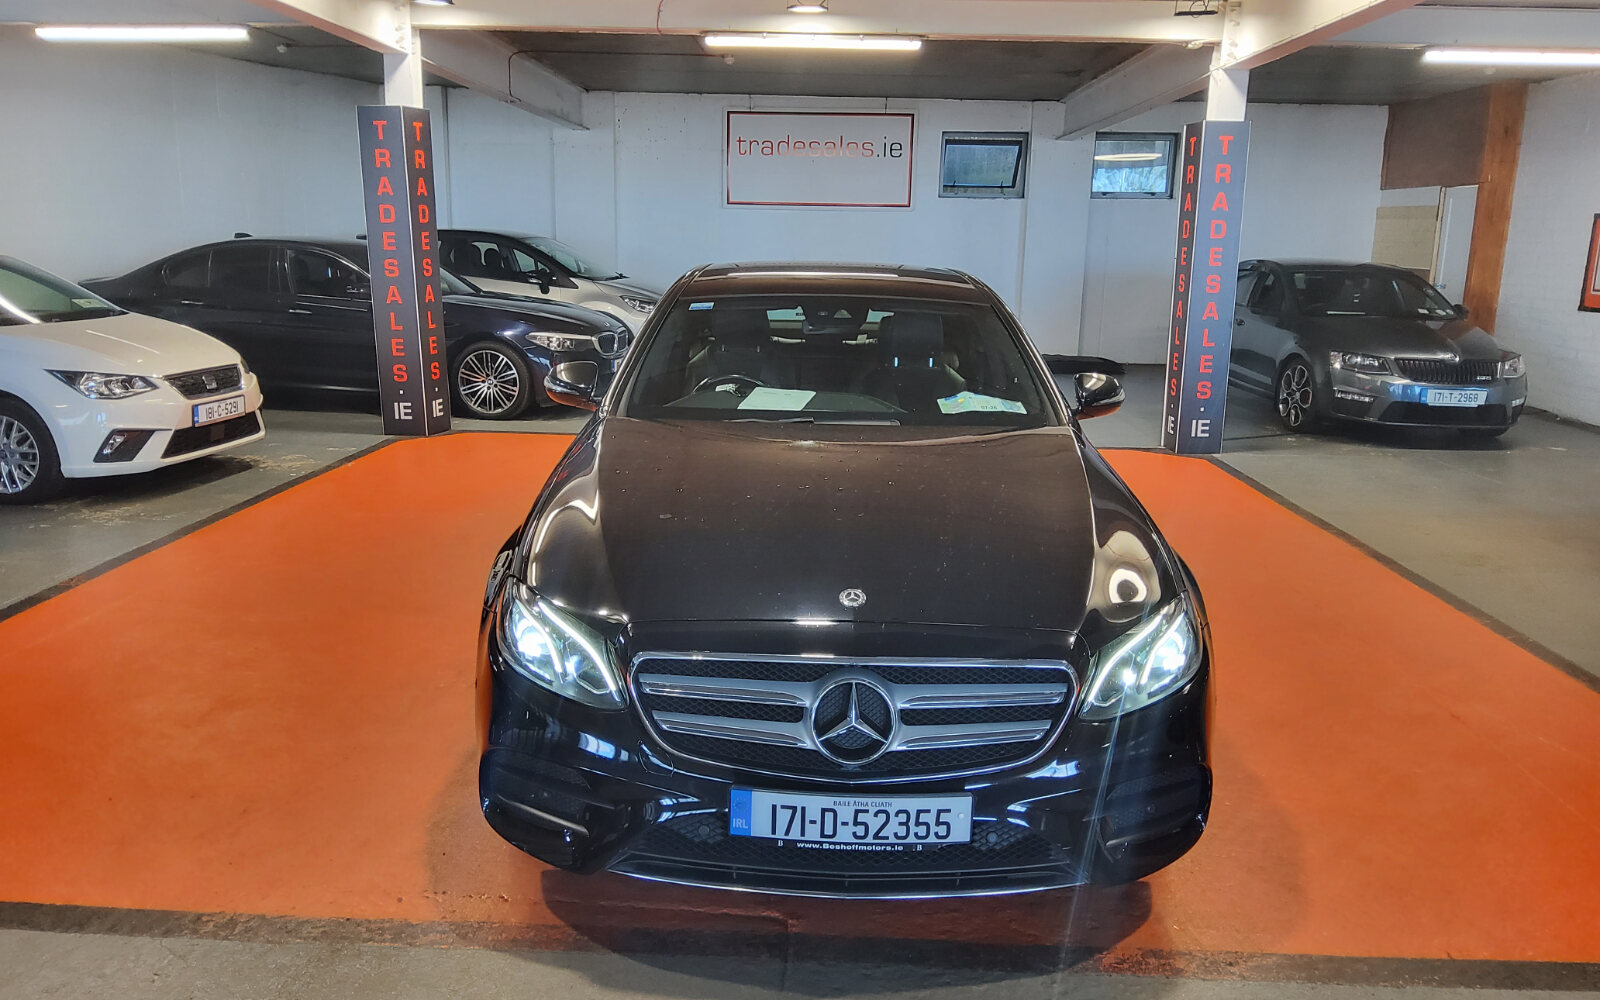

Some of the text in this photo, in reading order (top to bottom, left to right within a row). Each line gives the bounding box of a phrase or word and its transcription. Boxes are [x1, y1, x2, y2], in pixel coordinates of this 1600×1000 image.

[736, 134, 903, 158] tradesales.ie
[205, 401, 239, 420] 181-C-5291
[732, 817, 749, 829] IRL
[771, 803, 952, 841] 171-D-52355
